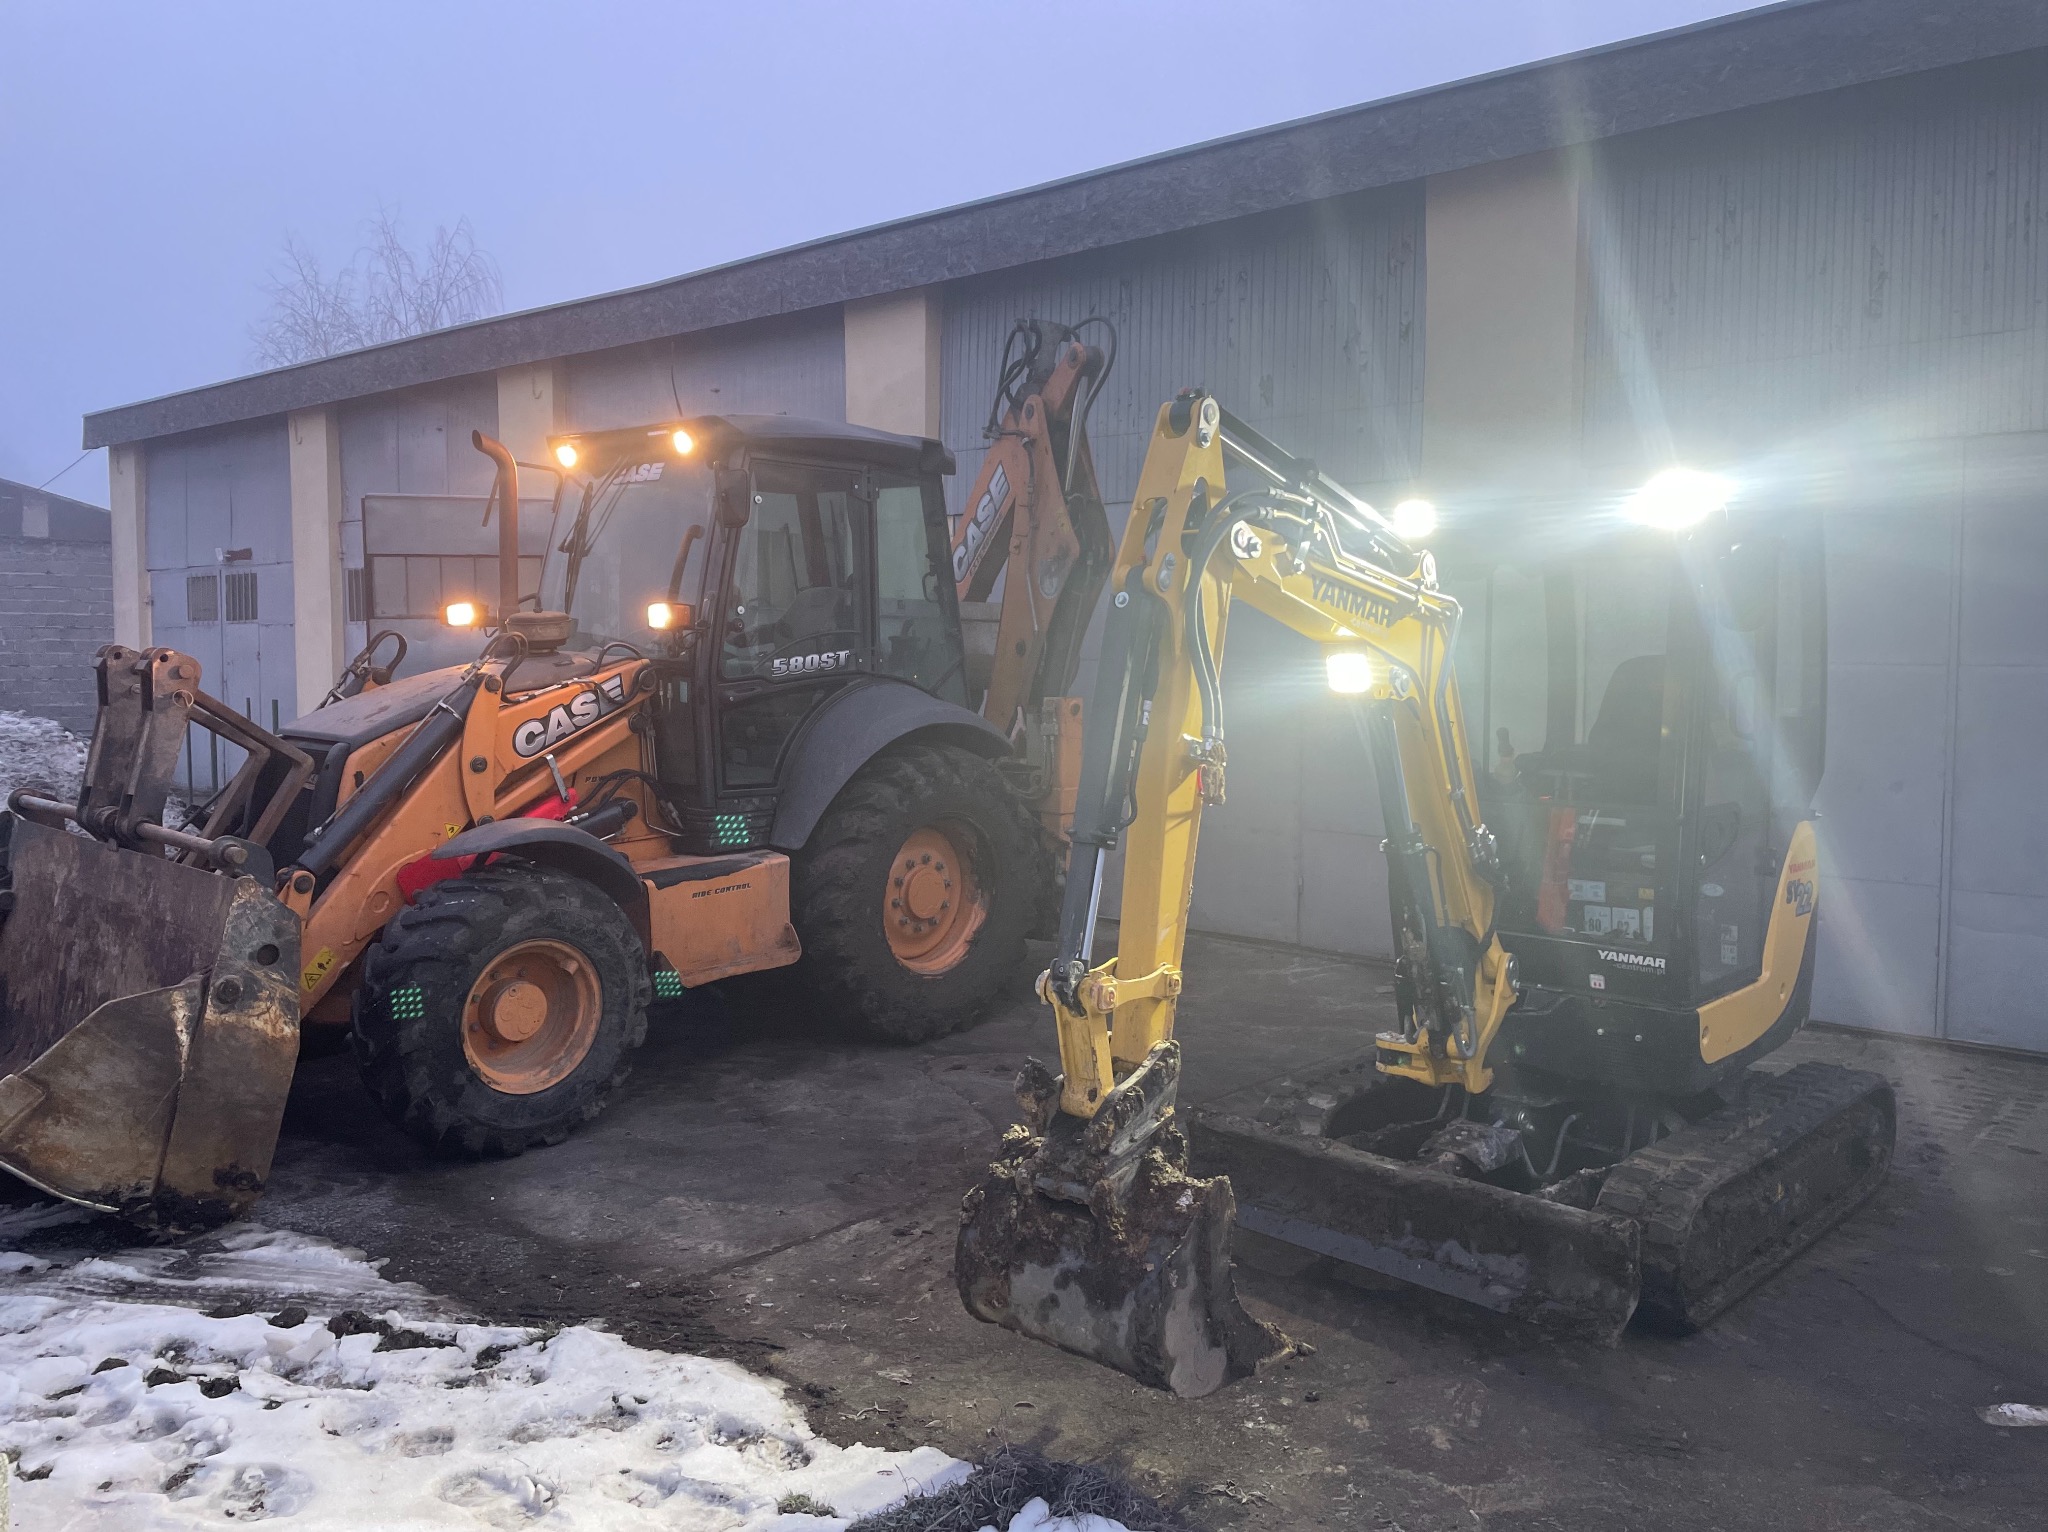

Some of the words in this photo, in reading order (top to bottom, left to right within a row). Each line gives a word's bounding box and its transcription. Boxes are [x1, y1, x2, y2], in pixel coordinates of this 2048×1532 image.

[952, 462, 1010, 583] CASE
[1311, 573, 1393, 628] YANMAR
[771, 649, 850, 677] 580ST
[513, 675, 624, 758] CASE
[691, 889, 712, 899] RIDE
[714, 882, 752, 895] CONTROL
[1597, 949, 1666, 969] YANMAR
